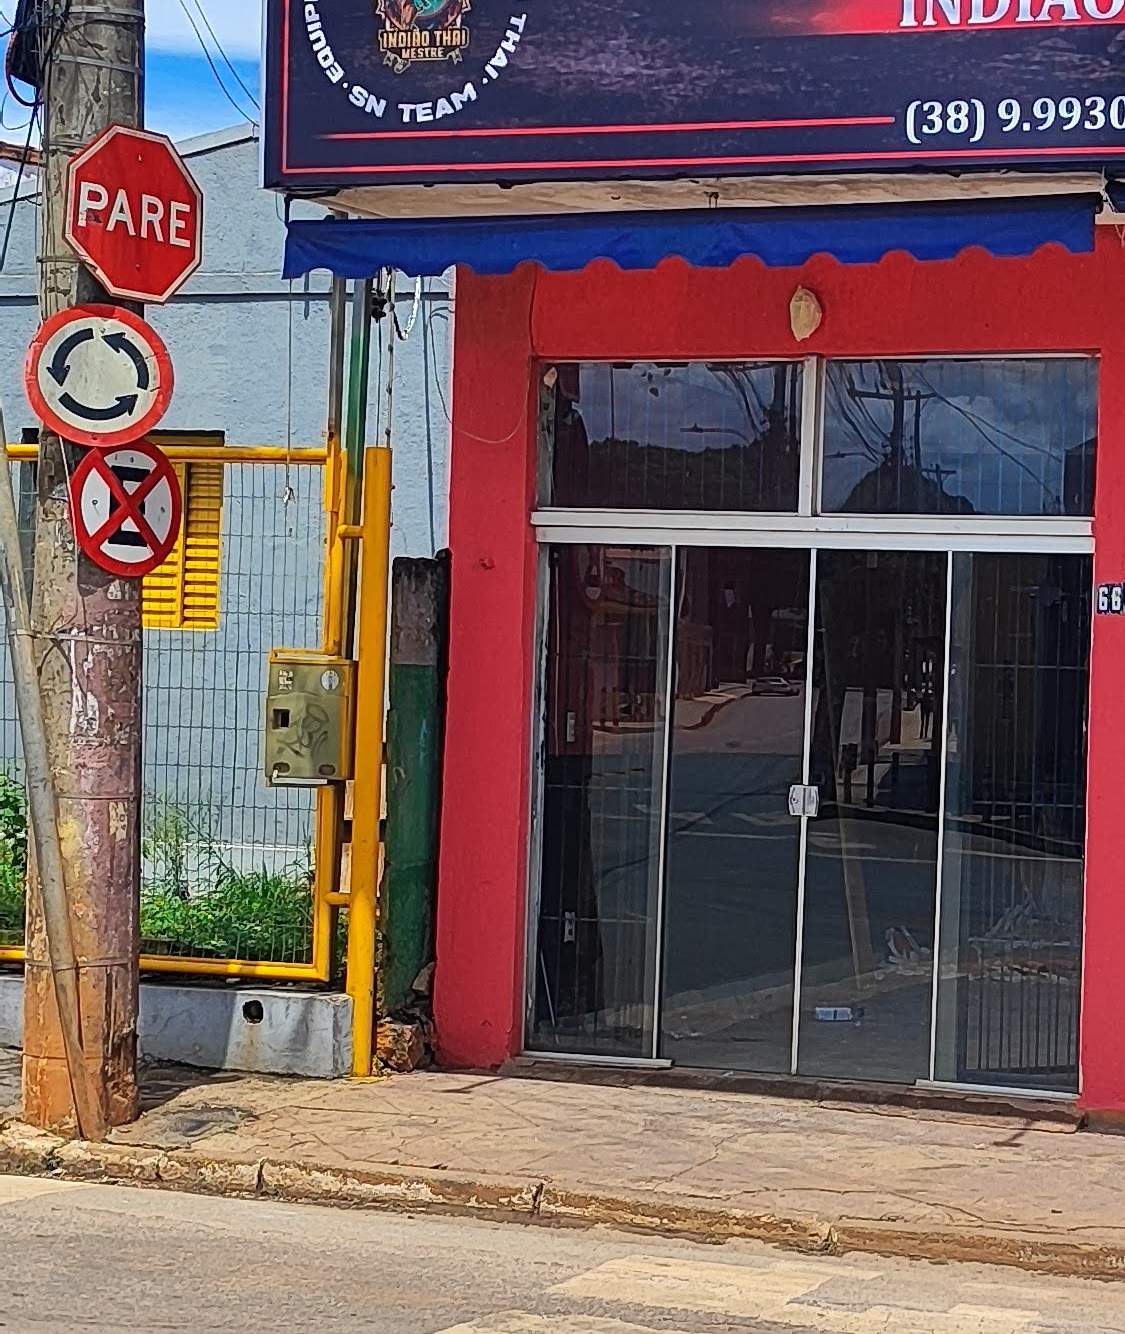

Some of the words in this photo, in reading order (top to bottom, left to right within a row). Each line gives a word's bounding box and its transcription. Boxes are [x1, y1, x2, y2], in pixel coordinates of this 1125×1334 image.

[401, 47, 445, 59] MESTRE
[434, 29, 466, 47] THAI
[484, 13, 527, 80] THAI
[348, 85, 388, 118] SN
[398, 81, 478, 123] TEAM
[904, 99, 986, 143] (38)
[78, 181, 192, 248] PARE
